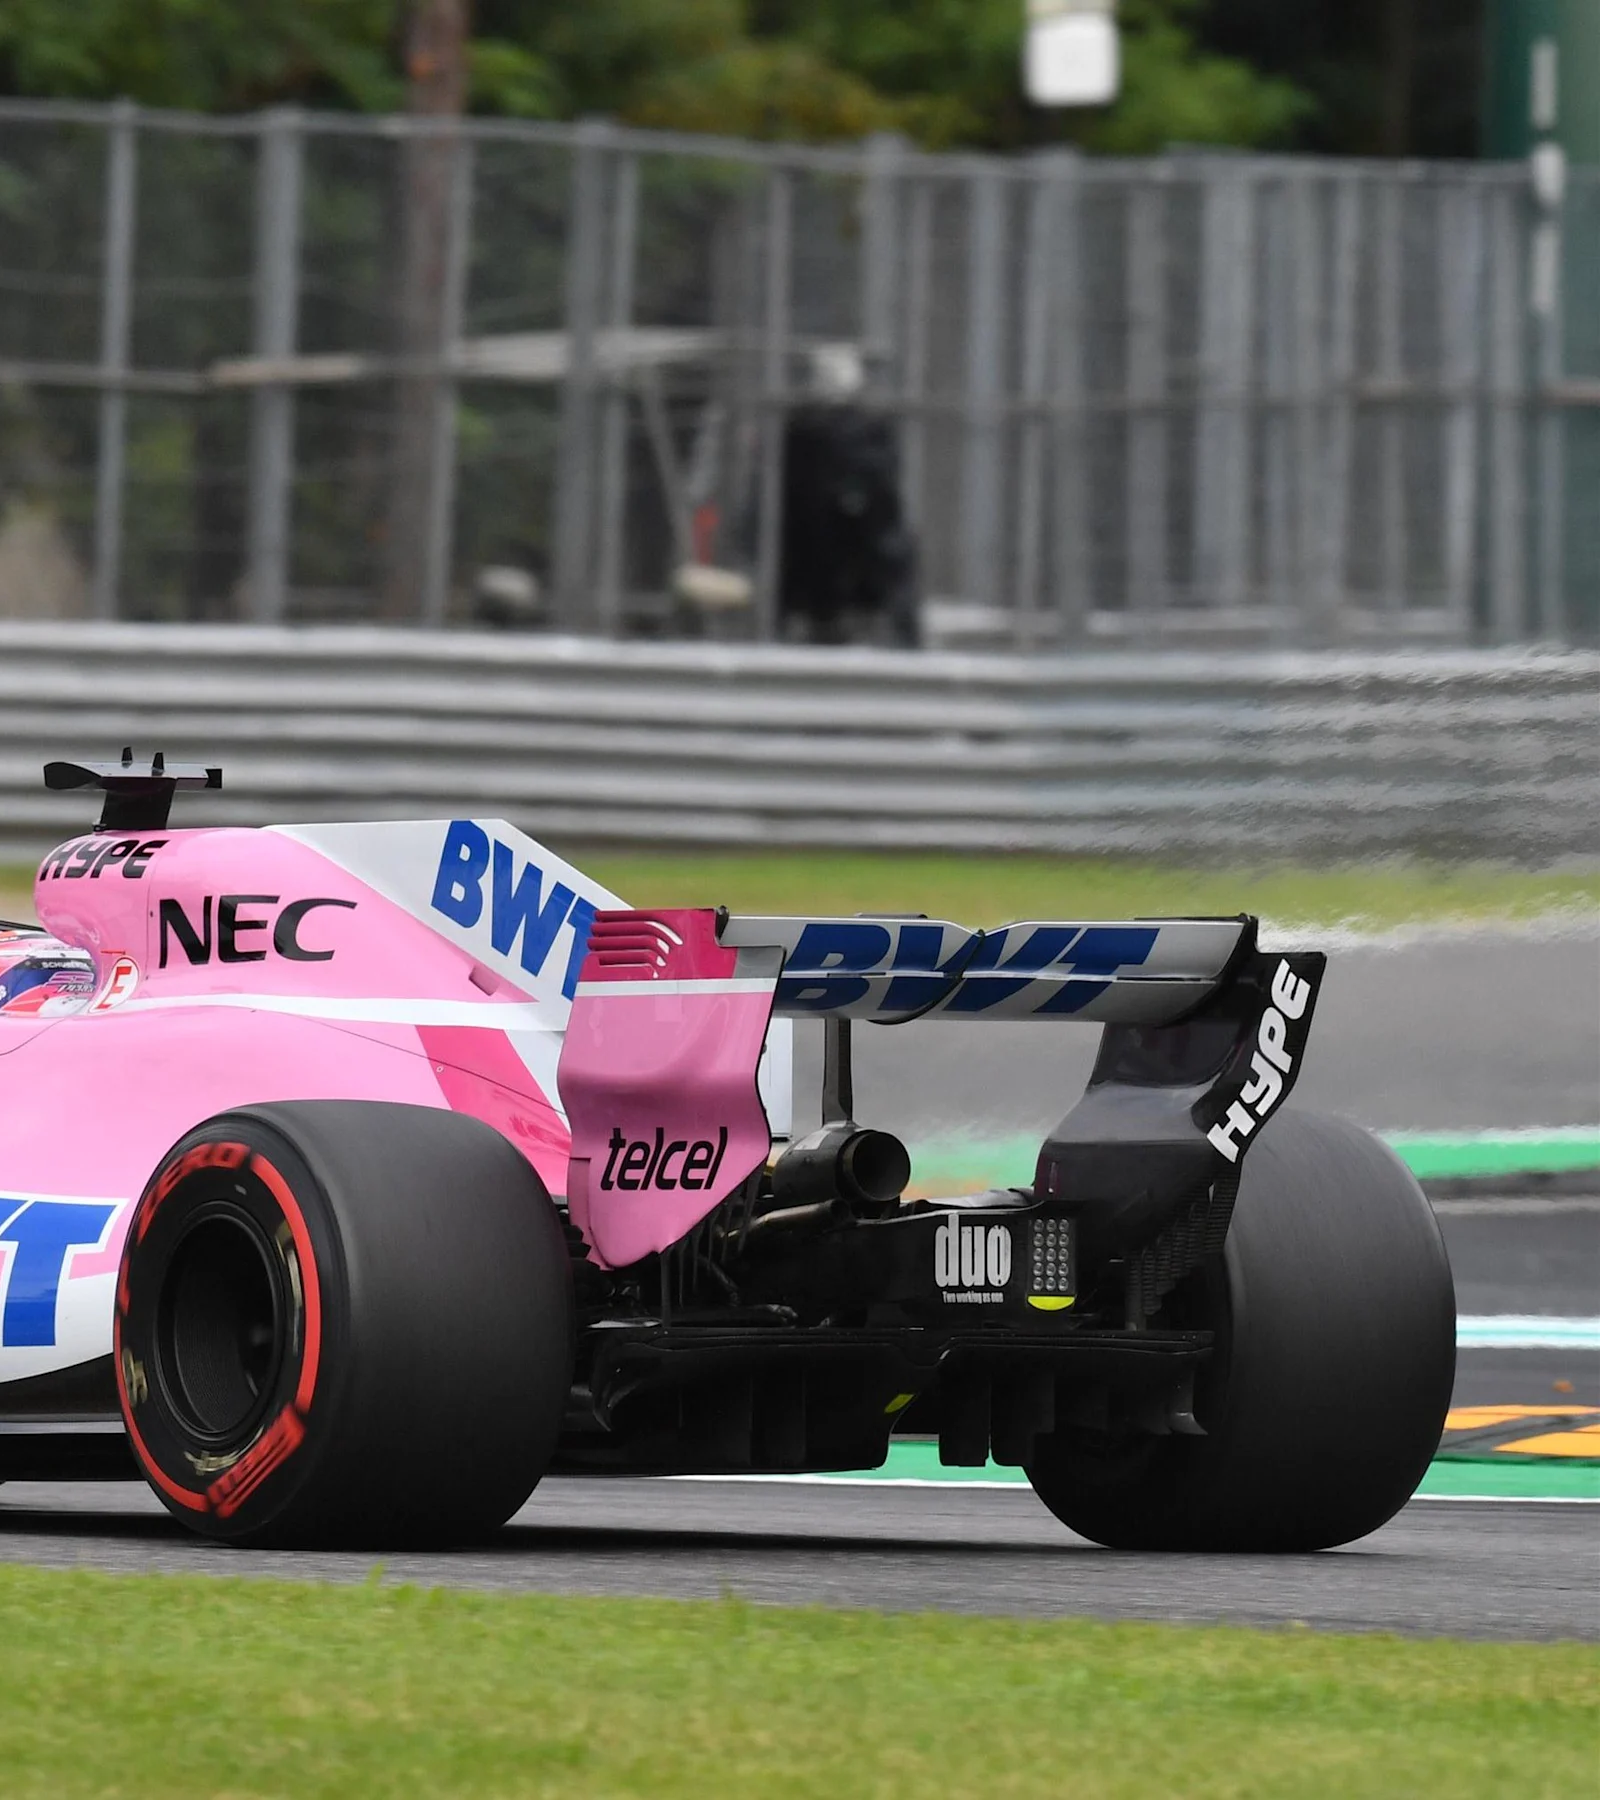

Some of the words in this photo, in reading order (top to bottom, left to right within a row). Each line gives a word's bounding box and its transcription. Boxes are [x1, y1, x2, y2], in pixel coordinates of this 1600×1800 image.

[39, 839, 170, 881] HYPE
[158, 895, 357, 968] NEC
[431, 820, 601, 1001] BWT
[776, 923, 1160, 1013] BWT
[1206, 958, 1311, 1164] HYPE
[600, 1126, 728, 1191] telcel
[934, 1213, 1012, 1287] duo
